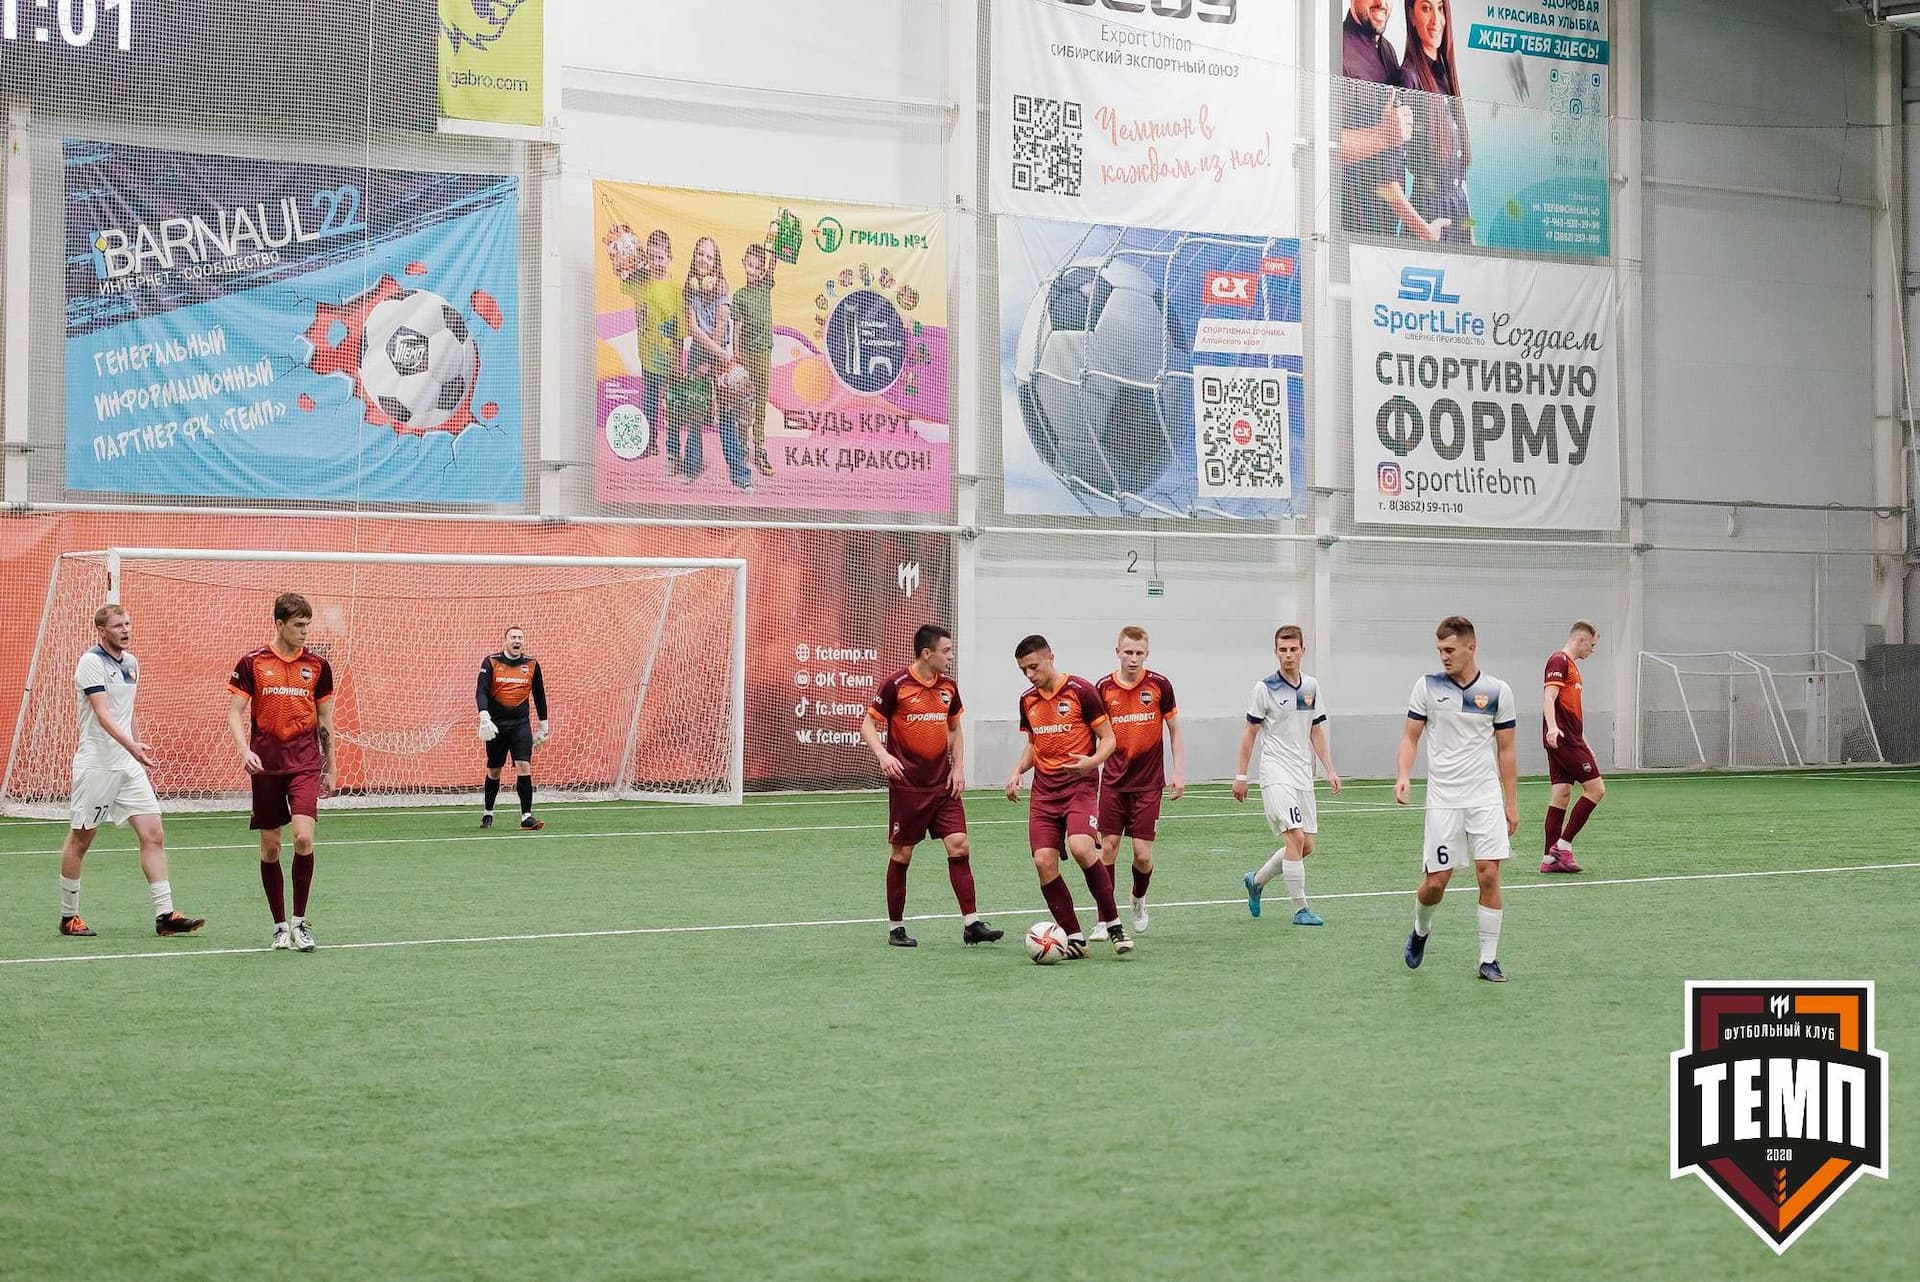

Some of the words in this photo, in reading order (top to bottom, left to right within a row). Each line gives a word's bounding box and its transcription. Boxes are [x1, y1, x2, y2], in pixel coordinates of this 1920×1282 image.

[1487, 6, 1494, 18] И
[1499, 7, 1555, 27] КРАСИВАЯ
[1558, 16, 1600, 32] УЛЫБКА
[1101, 24, 1148, 47] Export
[1152, 30, 1192, 53] Union
[1478, 29, 1517, 49] ЖДЕТ
[1520, 35, 1552, 53] ТЕБЯ
[1554, 39, 1600, 59] ЗДЕСЬ!
[1050, 43, 1122, 65] СИБИРСКИЙ
[1126, 53, 1206, 75] ЭКСПОРТНЫЙ
[1208, 63, 1239, 78] СОЮЗ
[1094, 106, 1196, 146] Чемпион
[1101, 146, 1197, 185] каждом
[1200, 153, 1225, 183] из
[1230, 131, 1271, 170] нас!
[849, 229, 900, 248] ГРИЛЬ
[183, 250, 280, 281] СООБЩЕСТВО
[1202, 326, 1251, 337] СПОРТИВНАЯ
[1374, 304, 1485, 336] SportLife
[93, 324, 227, 377] ГЕНЕРАЛЬНЫЙ
[1491, 311, 1603, 360] Создаем
[94, 354, 274, 422] ИНФОРМАЦИОННЫЙ
[1375, 351, 1597, 398] СПОРТИВНУЮ
[93, 421, 178, 463] ПАРТНЕР
[183, 413, 215, 442] ФК
[783, 409, 853, 437] БУДЬ
[860, 412, 919, 439] КРУТ,
[1375, 395, 1597, 466] ФОРМУ
[784, 446, 830, 468] КАК
[835, 448, 932, 473] ДРАКОН!
[1404, 466, 1537, 498] sportlifebrn
[1389, 500, 1425, 514] 8(3852)
[1127, 550, 1138, 573] 2
[815, 645, 878, 664] fctemp.ru
[815, 671, 836, 688] ФК
[838, 671, 874, 688] Темп
[815, 700, 865, 718] fc.temp
[93, 804, 109, 824] 77
[1289, 806, 1302, 825] 18
[1437, 845, 1449, 865] 6
